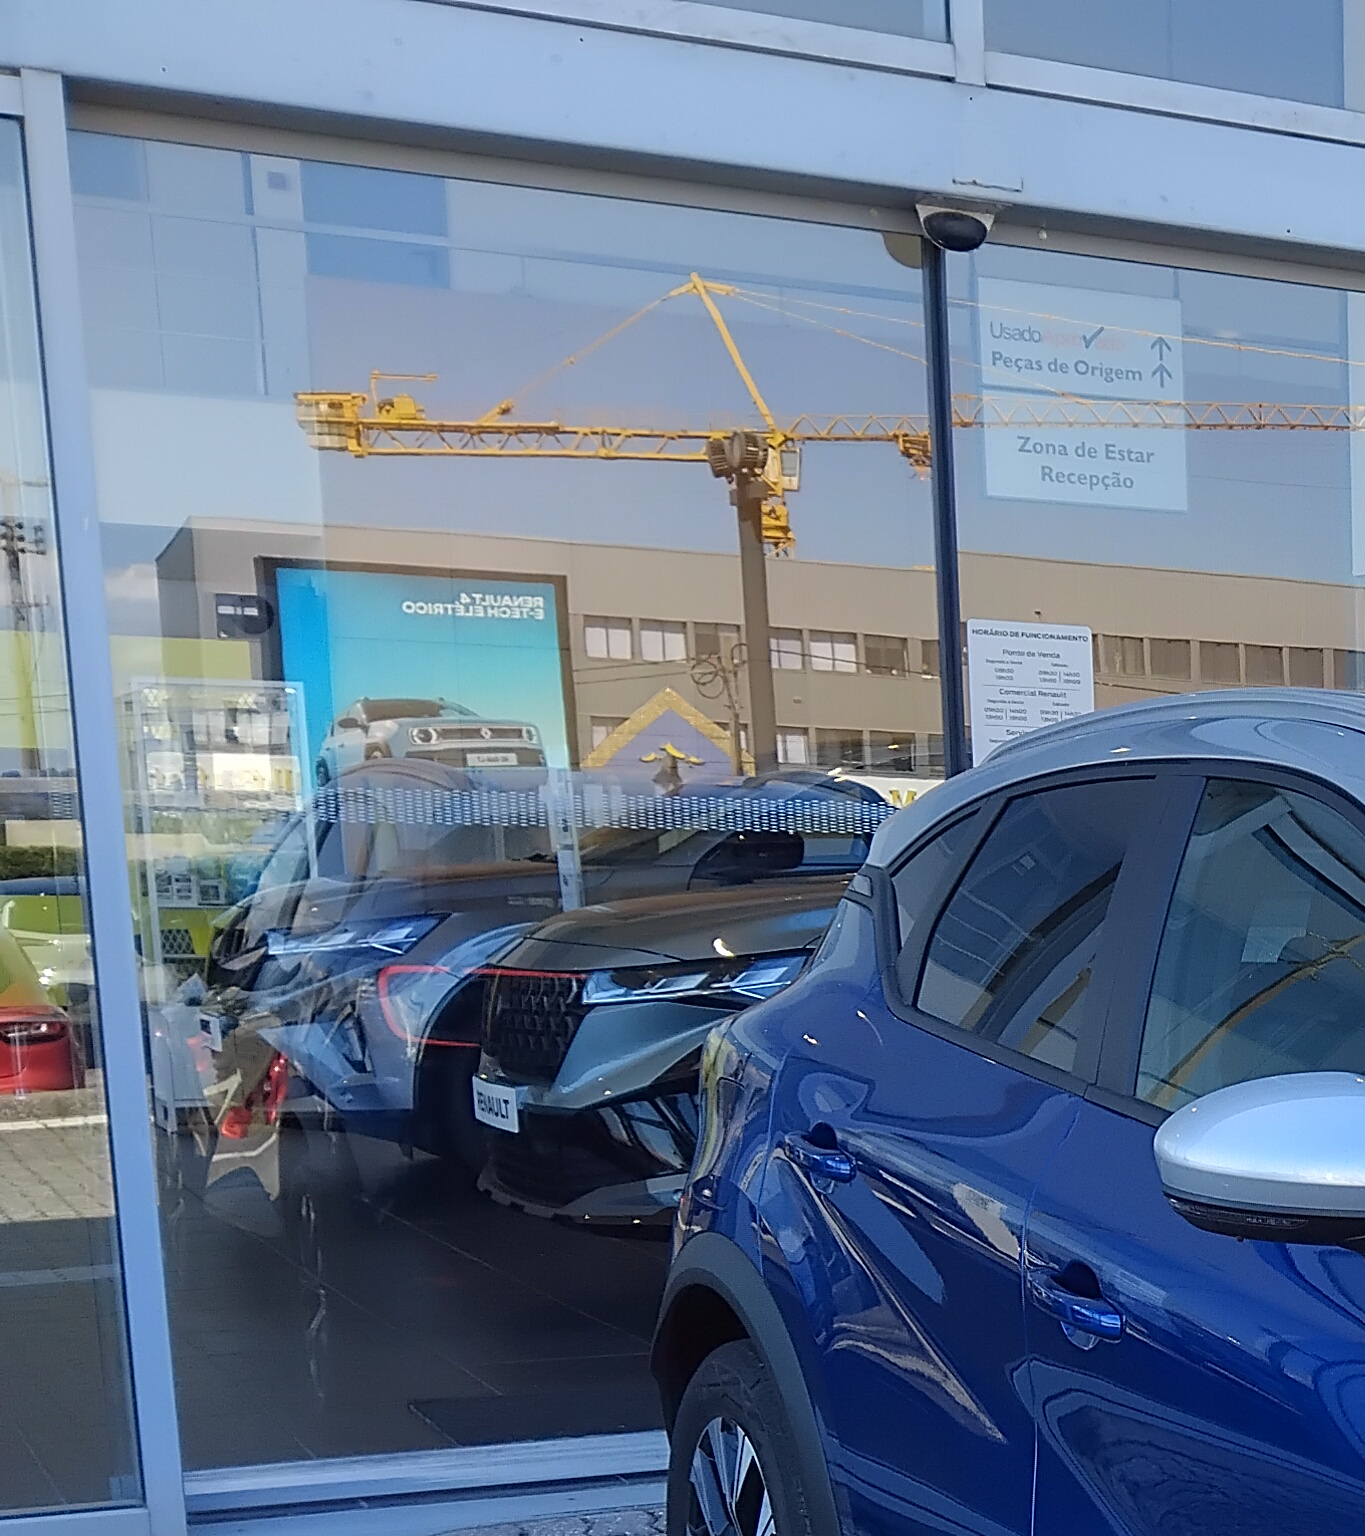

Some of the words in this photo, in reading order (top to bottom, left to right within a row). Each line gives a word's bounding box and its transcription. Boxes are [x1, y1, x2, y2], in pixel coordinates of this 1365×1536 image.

[990, 321, 1042, 344] Usado
[991, 350, 1043, 373] Peças
[1047, 358, 1069, 375] de
[1074, 360, 1143, 383] Origem
[1017, 436, 1069, 457] Zona
[1074, 441, 1098, 459] de
[1104, 443, 1155, 464] Estar
[1040, 465, 1135, 491] Recepção
[972, 628, 1009, 638] HORÁRIO
[1021, 632, 1089, 643] FUNCIONAMENTO
[1002, 648, 1026, 657] Ponto
[1026, 650, 1036, 658] de
[1037, 651, 1061, 659] Venda
[999, 688, 1037, 697] Comercial
[1038, 690, 1067, 699] Renault
[477, 1090, 510, 1119] RENAULT
